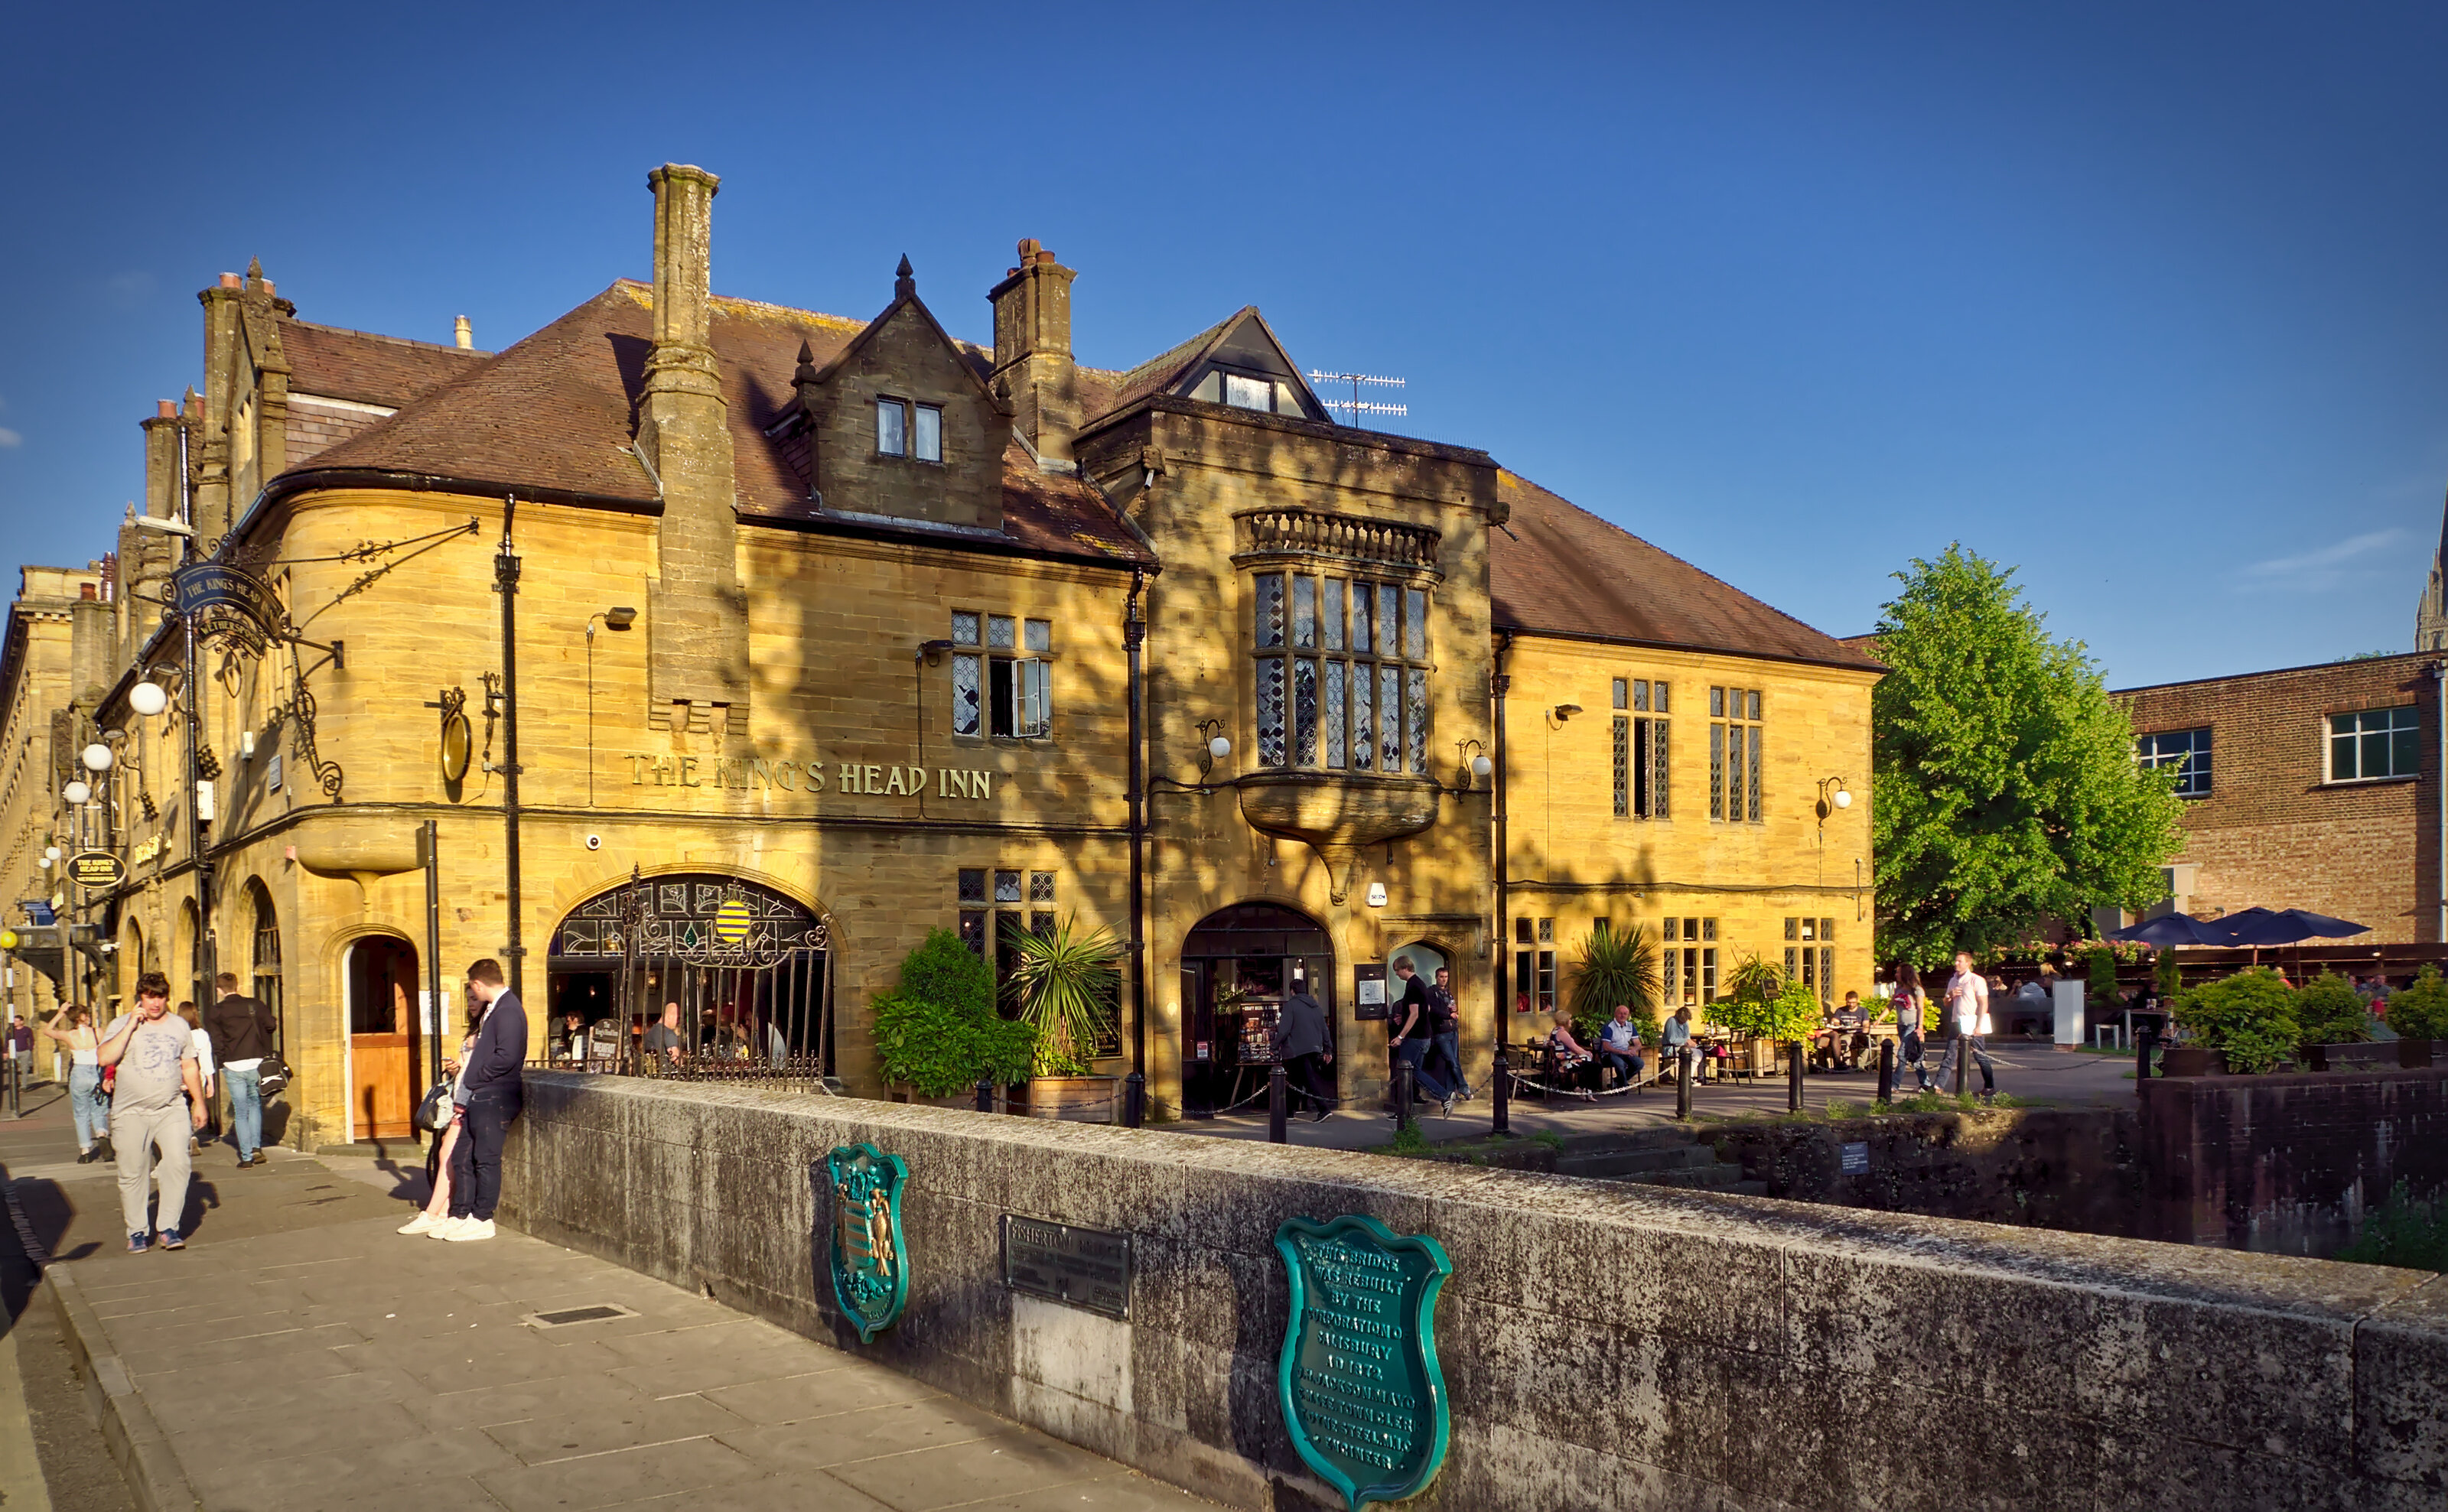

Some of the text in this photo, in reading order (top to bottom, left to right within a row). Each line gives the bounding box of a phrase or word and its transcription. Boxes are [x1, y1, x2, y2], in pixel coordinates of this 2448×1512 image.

[185, 581, 205, 598] THE
[236, 583, 261, 603] HEAD
[200, 620, 262, 647] WETHERSPOON
[624, 753, 991, 799] THE KING'S HEAD INN
[1012, 1224, 1071, 1252] FISHERTON
[1317, 1243, 1399, 1272] THIS BRIDGE
[1315, 1266, 1403, 1296] WAS REBUILT
[1332, 1290, 1381, 1313] BY THE
[1308, 1307, 1390, 1339] CORPORATION
[1317, 1331, 1392, 1360] SALISBURY
[1327, 1354, 1382, 1380] AD 1872
[1338, 1400, 1373, 1422] TOWN
